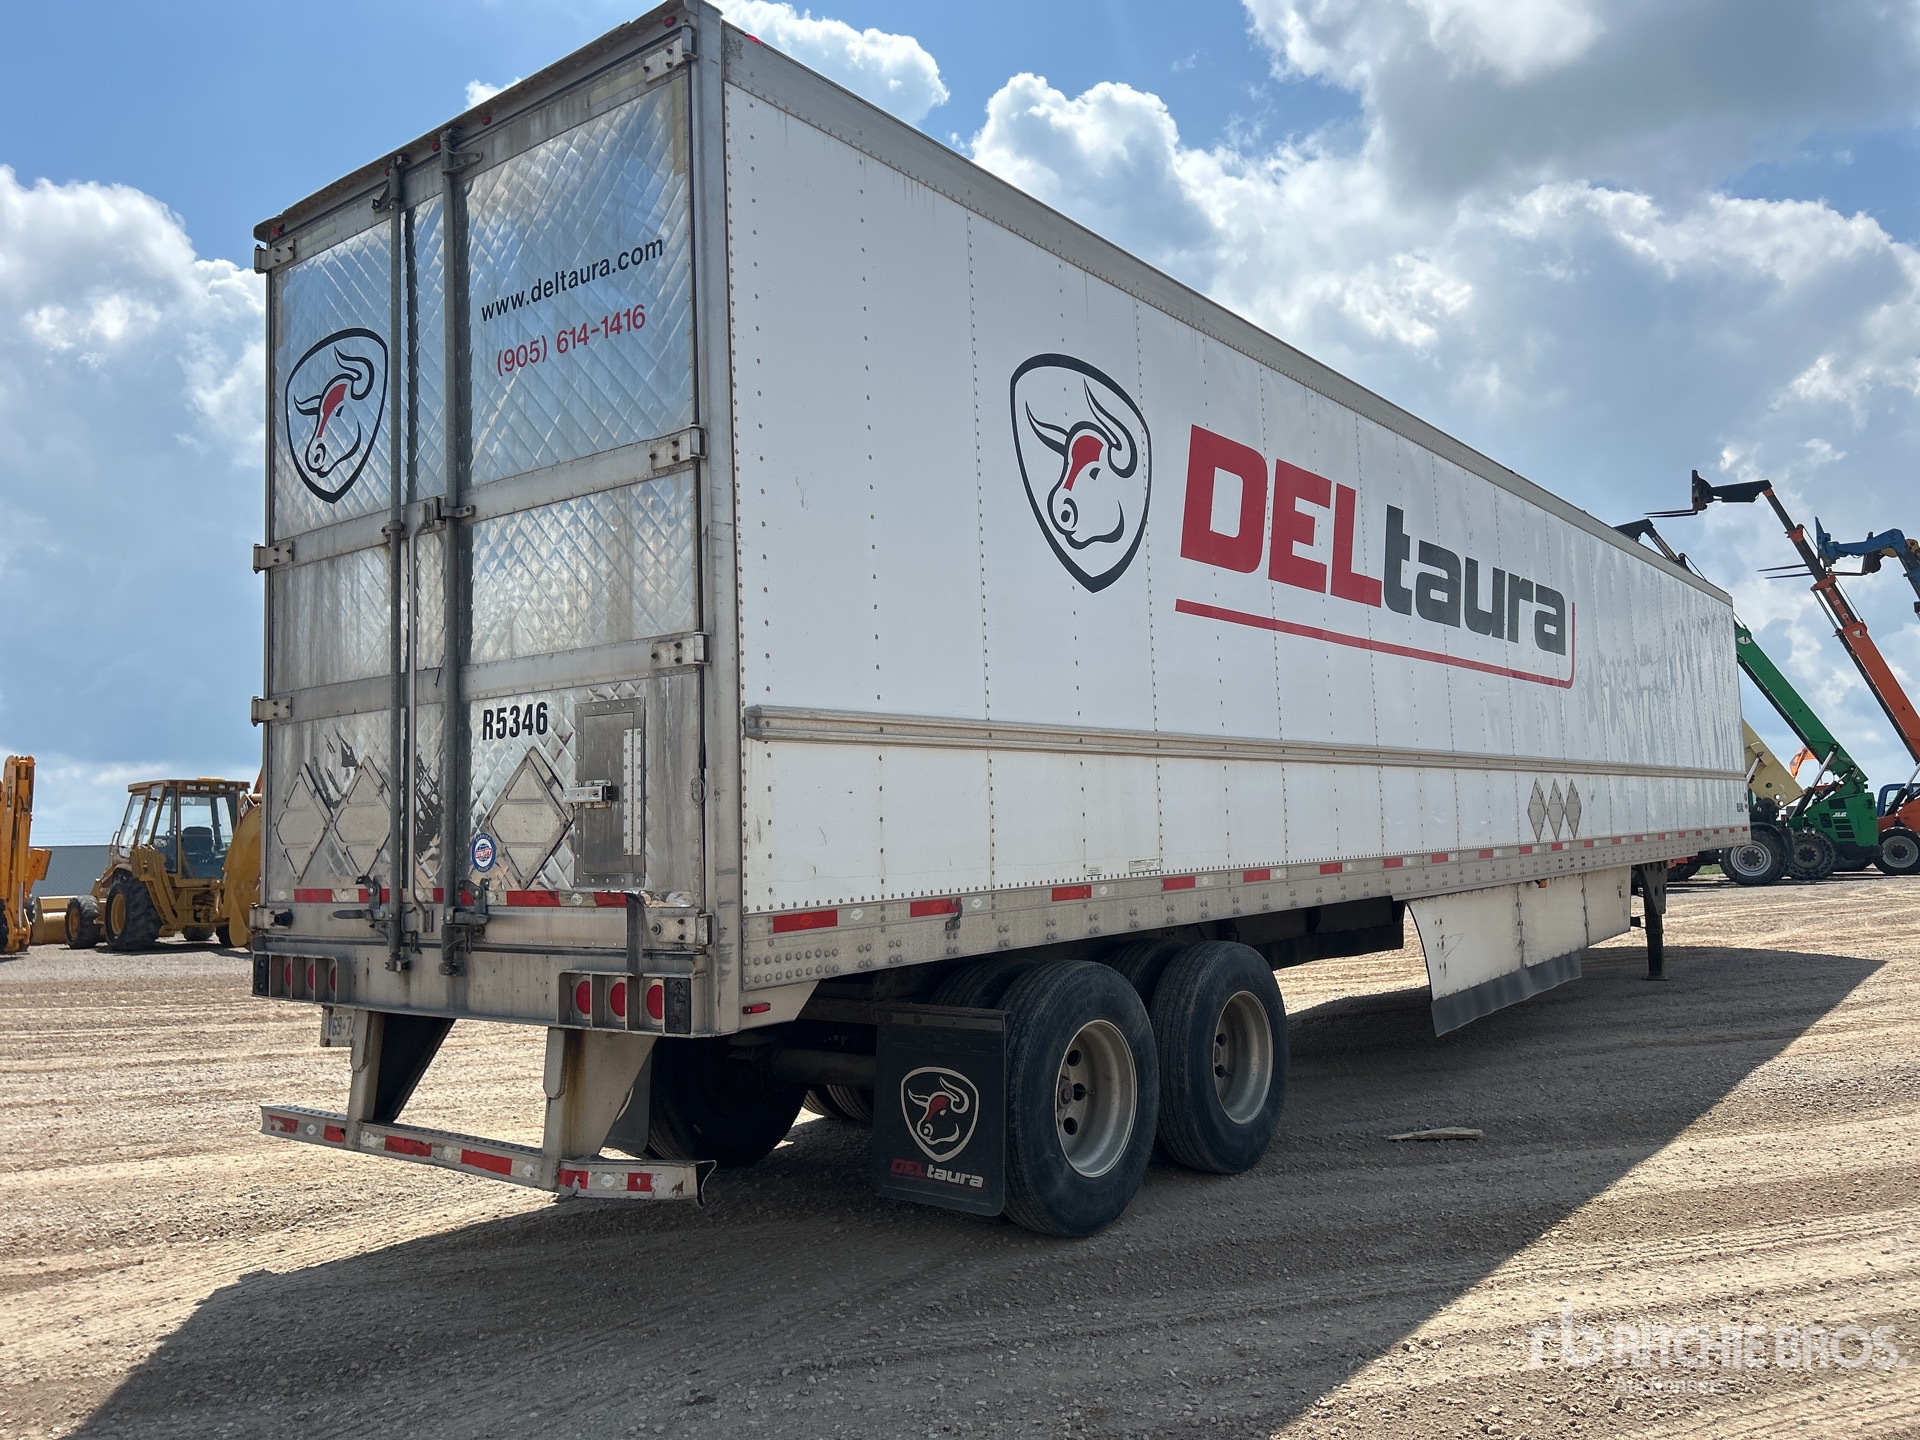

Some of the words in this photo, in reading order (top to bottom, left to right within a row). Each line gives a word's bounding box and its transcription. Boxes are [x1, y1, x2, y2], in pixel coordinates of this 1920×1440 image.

[481, 238, 664, 322] www.deltaura.com
[496, 334, 549, 377] (905)
[556, 304, 647, 355] 614-1416
[482, 701, 548, 740] R5346
